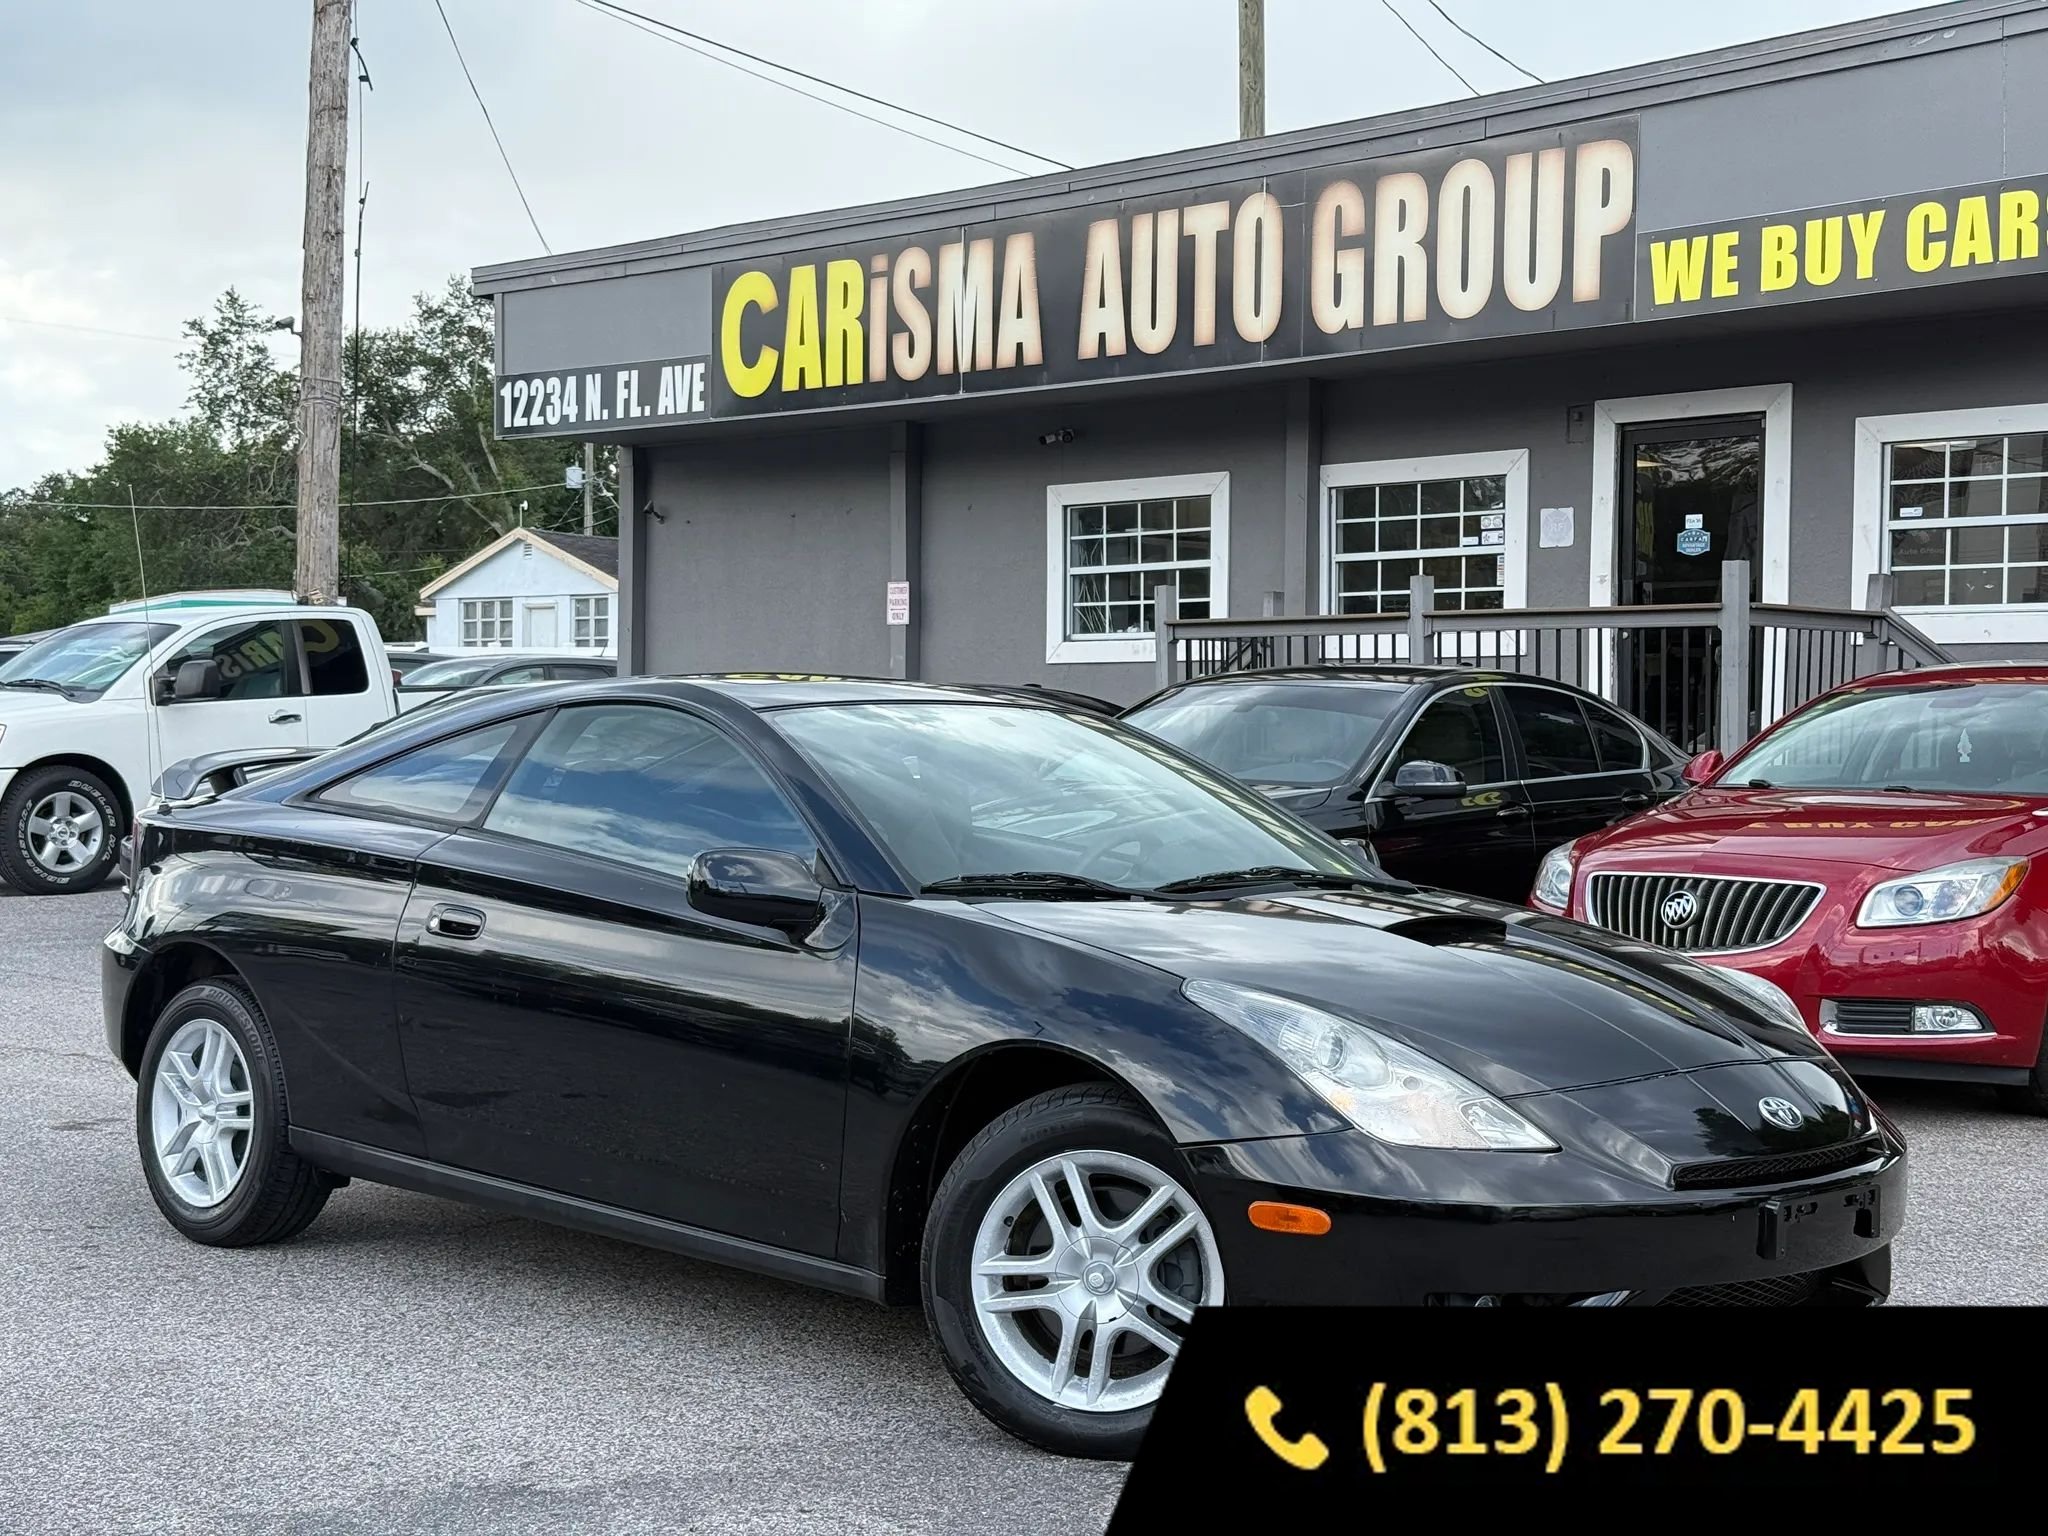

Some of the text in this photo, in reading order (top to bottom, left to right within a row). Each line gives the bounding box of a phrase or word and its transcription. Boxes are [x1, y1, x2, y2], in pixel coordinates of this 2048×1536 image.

[1077, 191, 1284, 360] AUTO
[1310, 139, 1635, 335] GROUP
[1650, 190, 2048, 305] WE BUY CAR
[500, 362, 706, 428] 12234 N. FL. AVE
